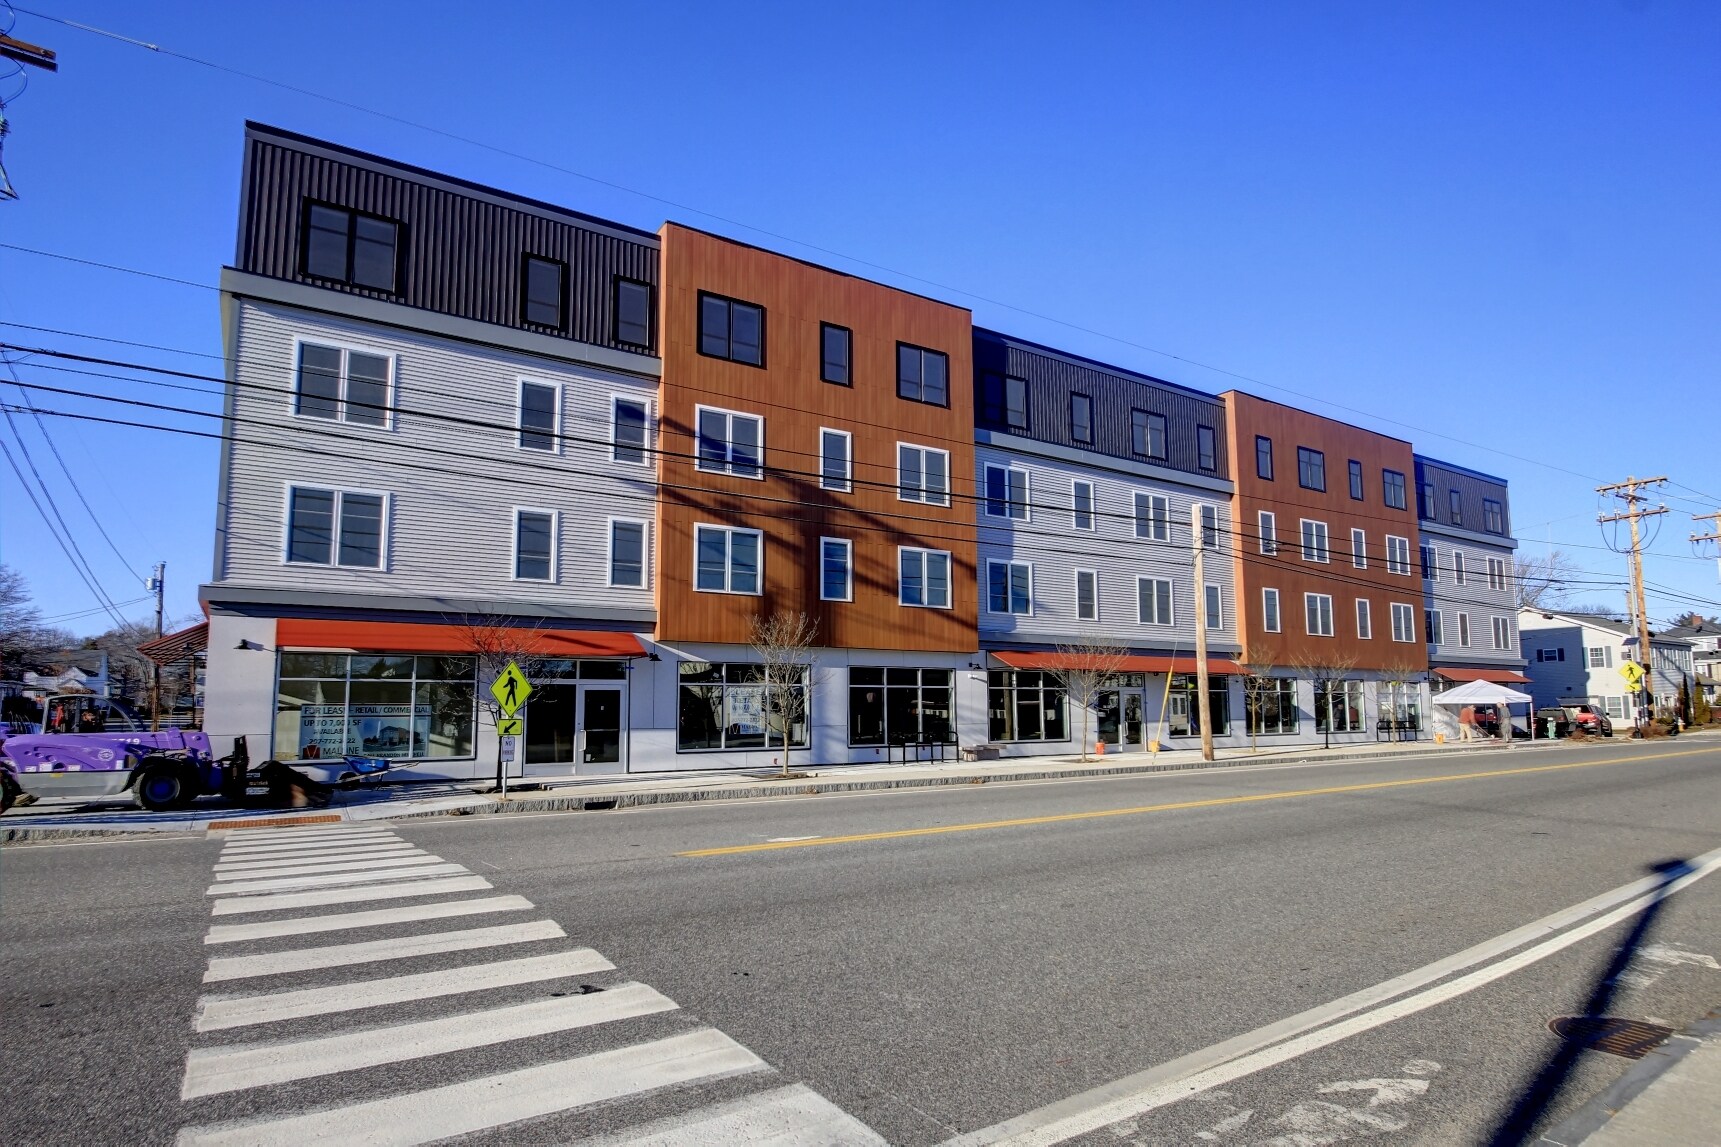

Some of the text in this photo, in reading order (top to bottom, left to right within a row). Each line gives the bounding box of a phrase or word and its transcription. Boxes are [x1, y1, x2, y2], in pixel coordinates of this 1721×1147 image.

[304, 706, 321, 714] FOR
[355, 706, 378, 714] RETAIL
[383, 706, 429, 714] COMMECIAL
